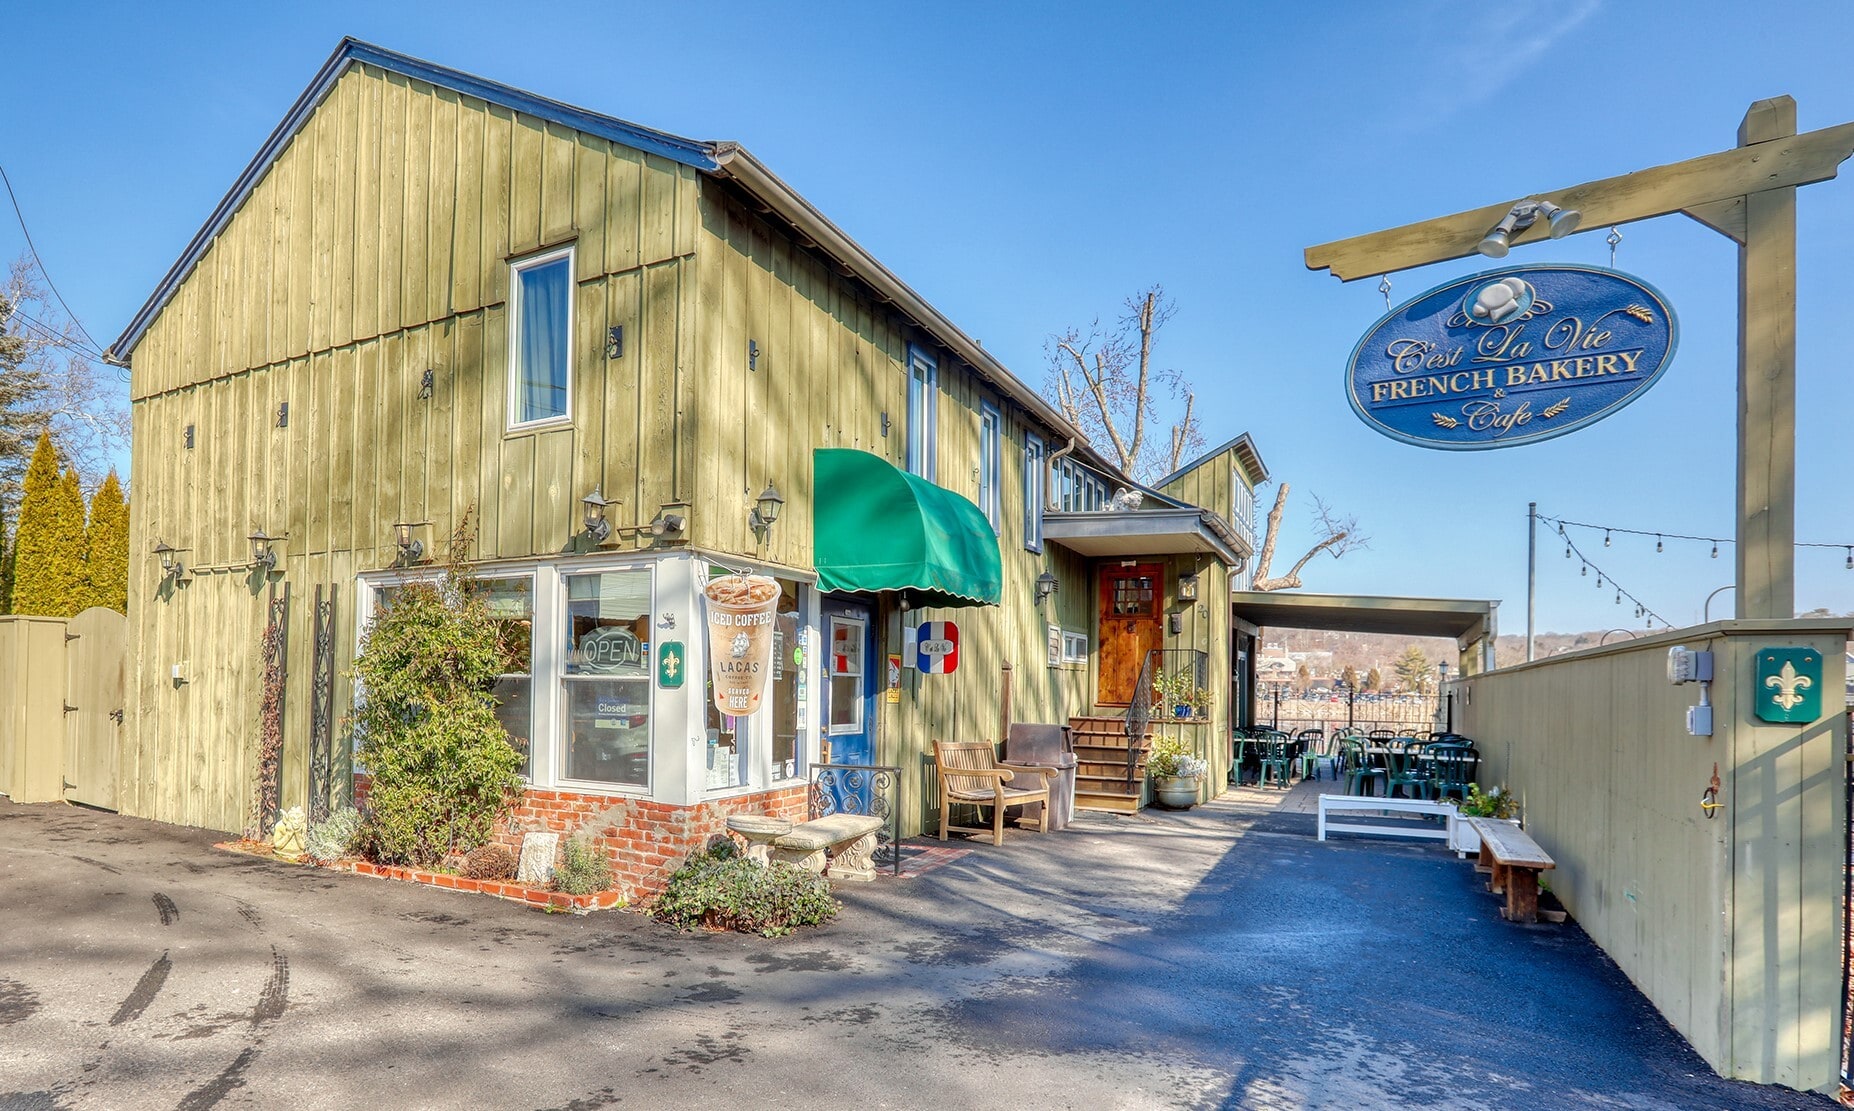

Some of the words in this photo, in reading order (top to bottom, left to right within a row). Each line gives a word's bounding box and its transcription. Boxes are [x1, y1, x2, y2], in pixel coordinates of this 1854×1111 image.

[1386, 338, 1462, 374] C'est
[1471, 324, 1531, 362] La
[1545, 317, 1612, 353] Vie
[1372, 368, 1495, 402] FRENCH
[1506, 350, 1643, 386] BAKERY
[1493, 387, 1506, 399] &
[1461, 400, 1531, 437] Cafe
[711, 611, 732, 626] ICED
[735, 611, 772, 627] COFFEE
[584, 640, 637, 662] OPEN
[720, 661, 759, 673] LACAS
[728, 687, 750, 695] SERVED
[598, 703, 626, 713] Closed
[729, 696, 748, 709] HERE
